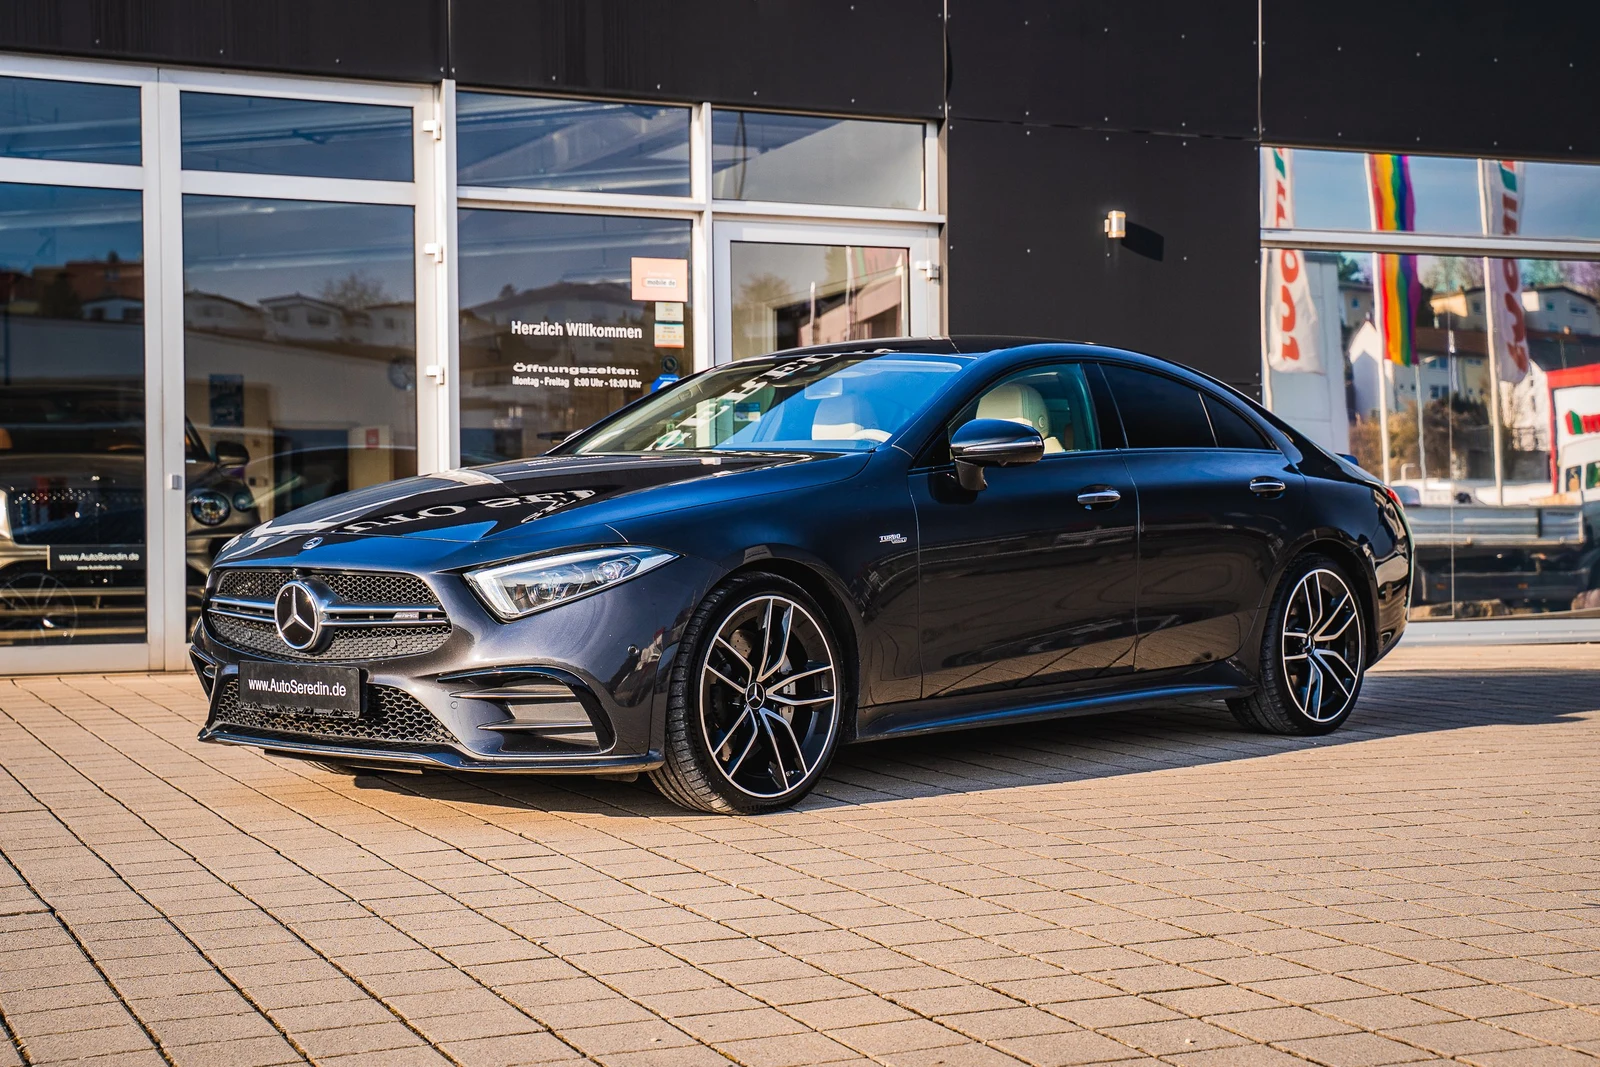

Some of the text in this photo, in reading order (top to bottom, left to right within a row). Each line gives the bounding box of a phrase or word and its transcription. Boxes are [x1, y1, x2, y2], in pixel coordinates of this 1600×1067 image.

[511, 320, 642, 338] Herzlich Willkommen
[512, 362, 639, 375] Öffnungszeiten:
[512, 376, 539, 388] Montag
[544, 376, 569, 388] Freitag
[590, 377, 604, 388] Uhr
[628, 379, 642, 388] Uhr
[248, 678, 347, 697] www.AutoSeredin.de
